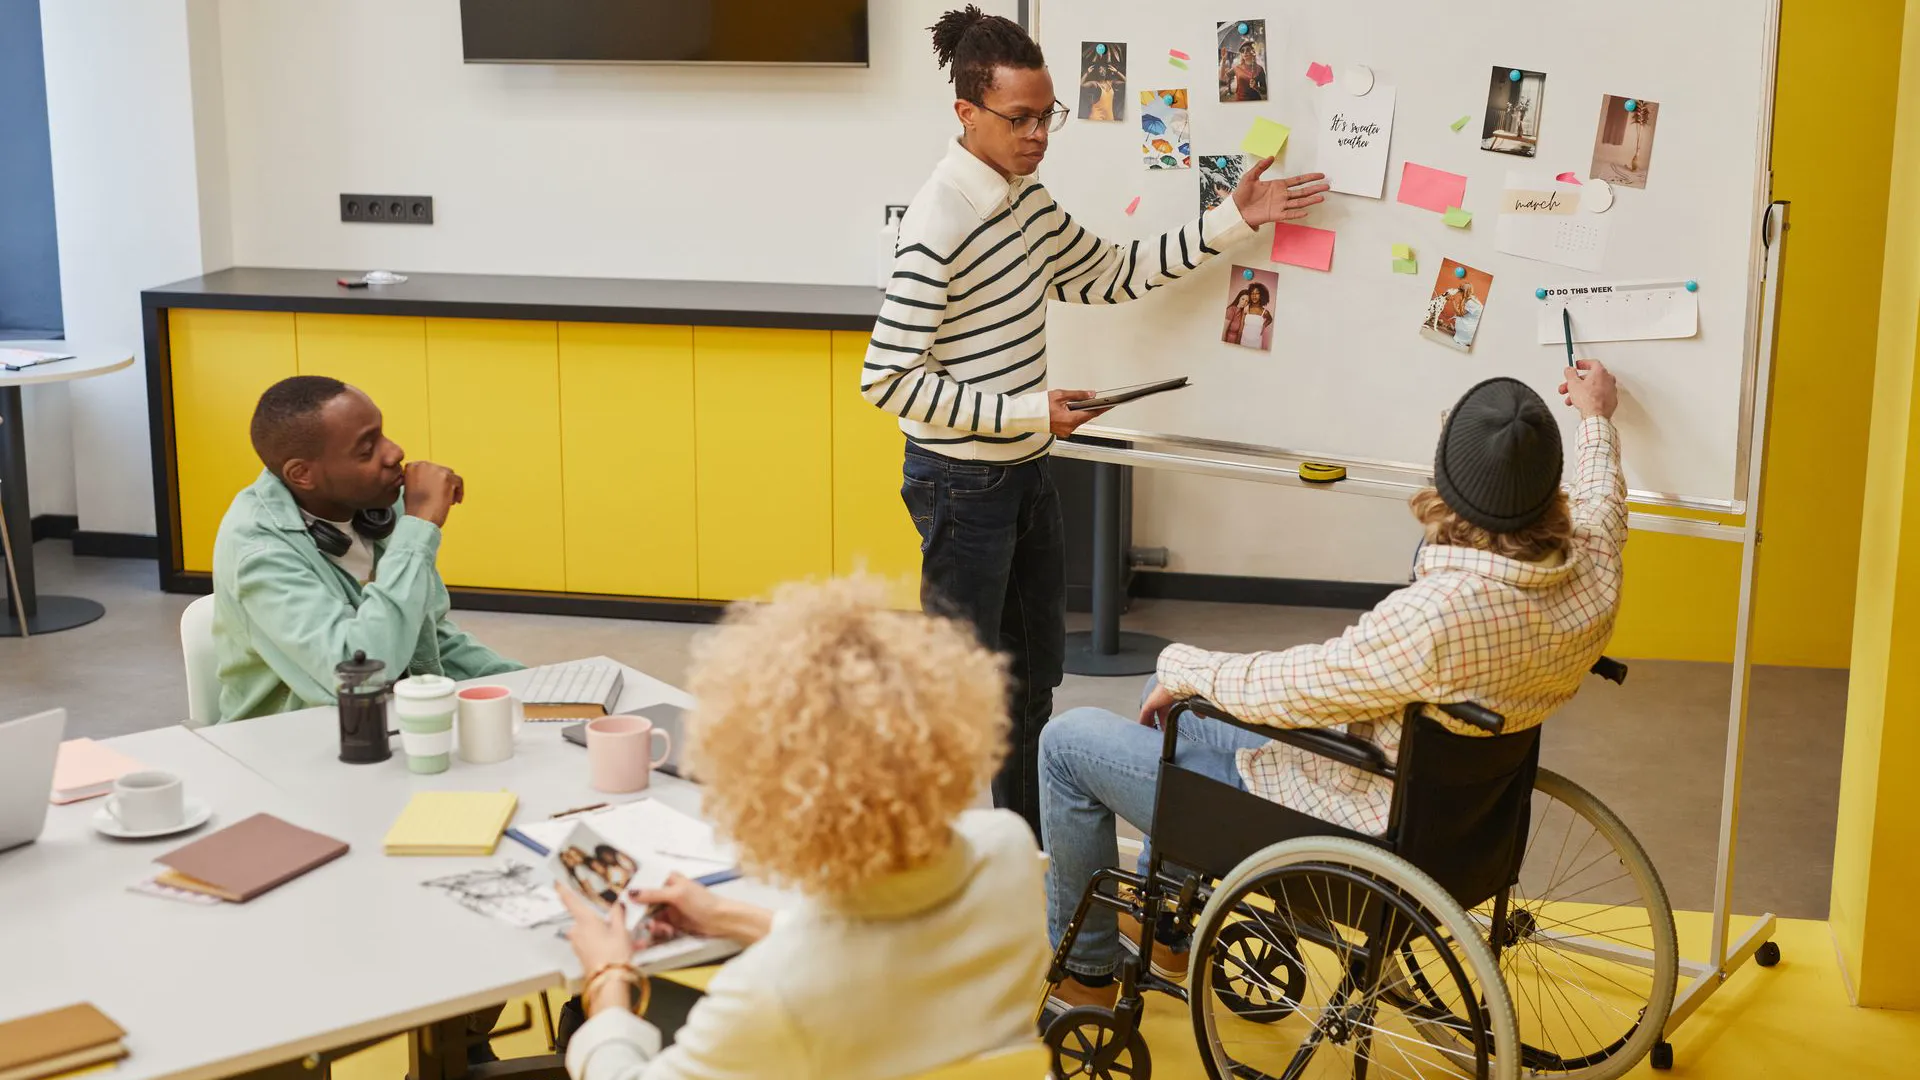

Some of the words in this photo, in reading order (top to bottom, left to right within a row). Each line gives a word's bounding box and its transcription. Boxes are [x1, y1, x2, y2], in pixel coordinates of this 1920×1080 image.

[1330, 113, 1347, 131] It's
[1350, 122, 1380, 136] sweater
[1338, 135, 1369, 149] weather
[1515, 190, 1560, 210] march
[1570, 287, 1588, 295] THIS
